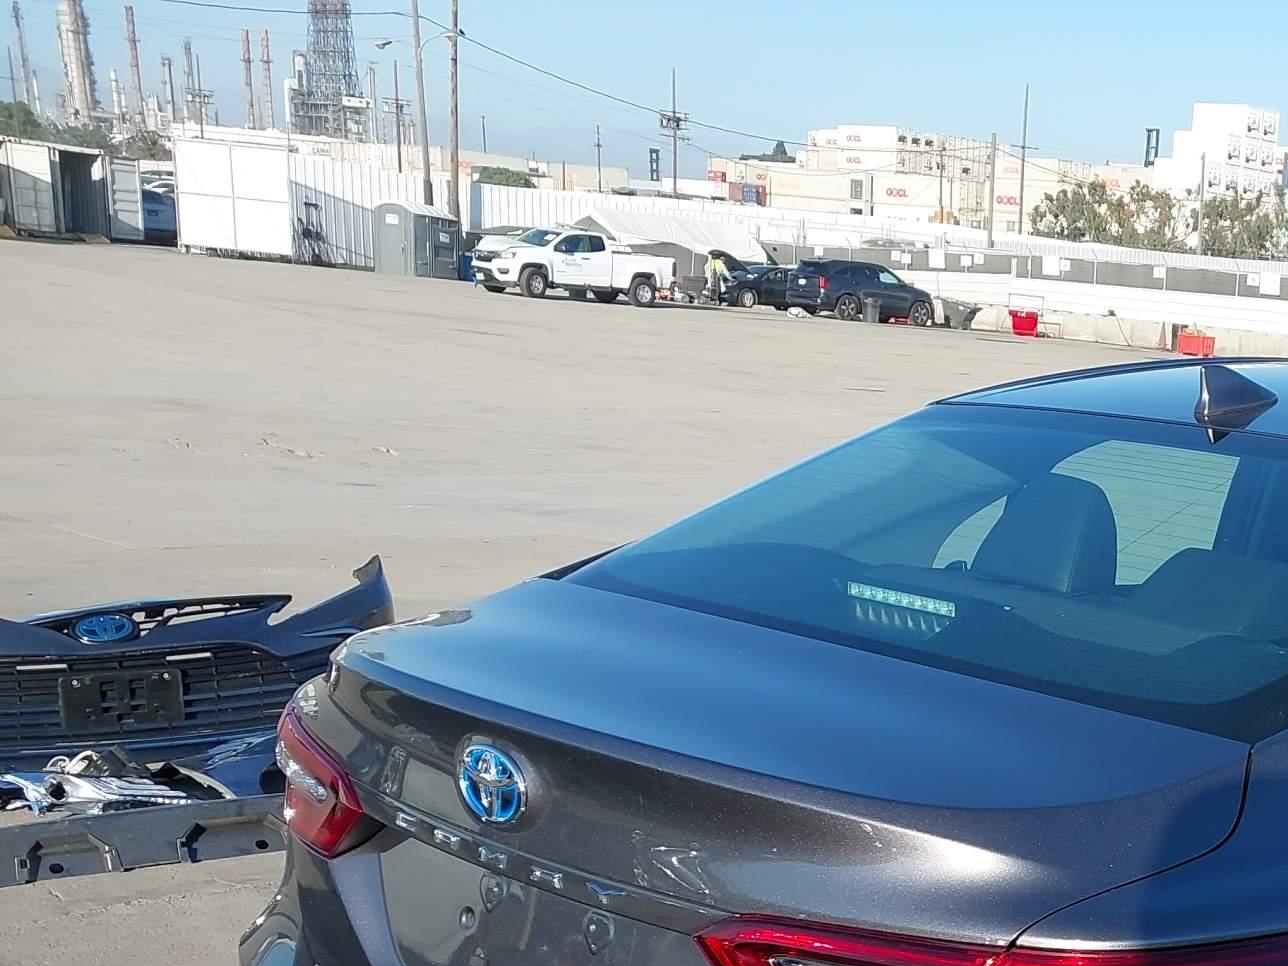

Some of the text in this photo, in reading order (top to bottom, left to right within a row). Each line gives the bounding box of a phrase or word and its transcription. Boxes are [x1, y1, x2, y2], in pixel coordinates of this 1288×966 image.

[886, 187, 909, 198] OOCL
[996, 195, 1020, 206] OOCL
[394, 811, 628, 905] CAMRY
